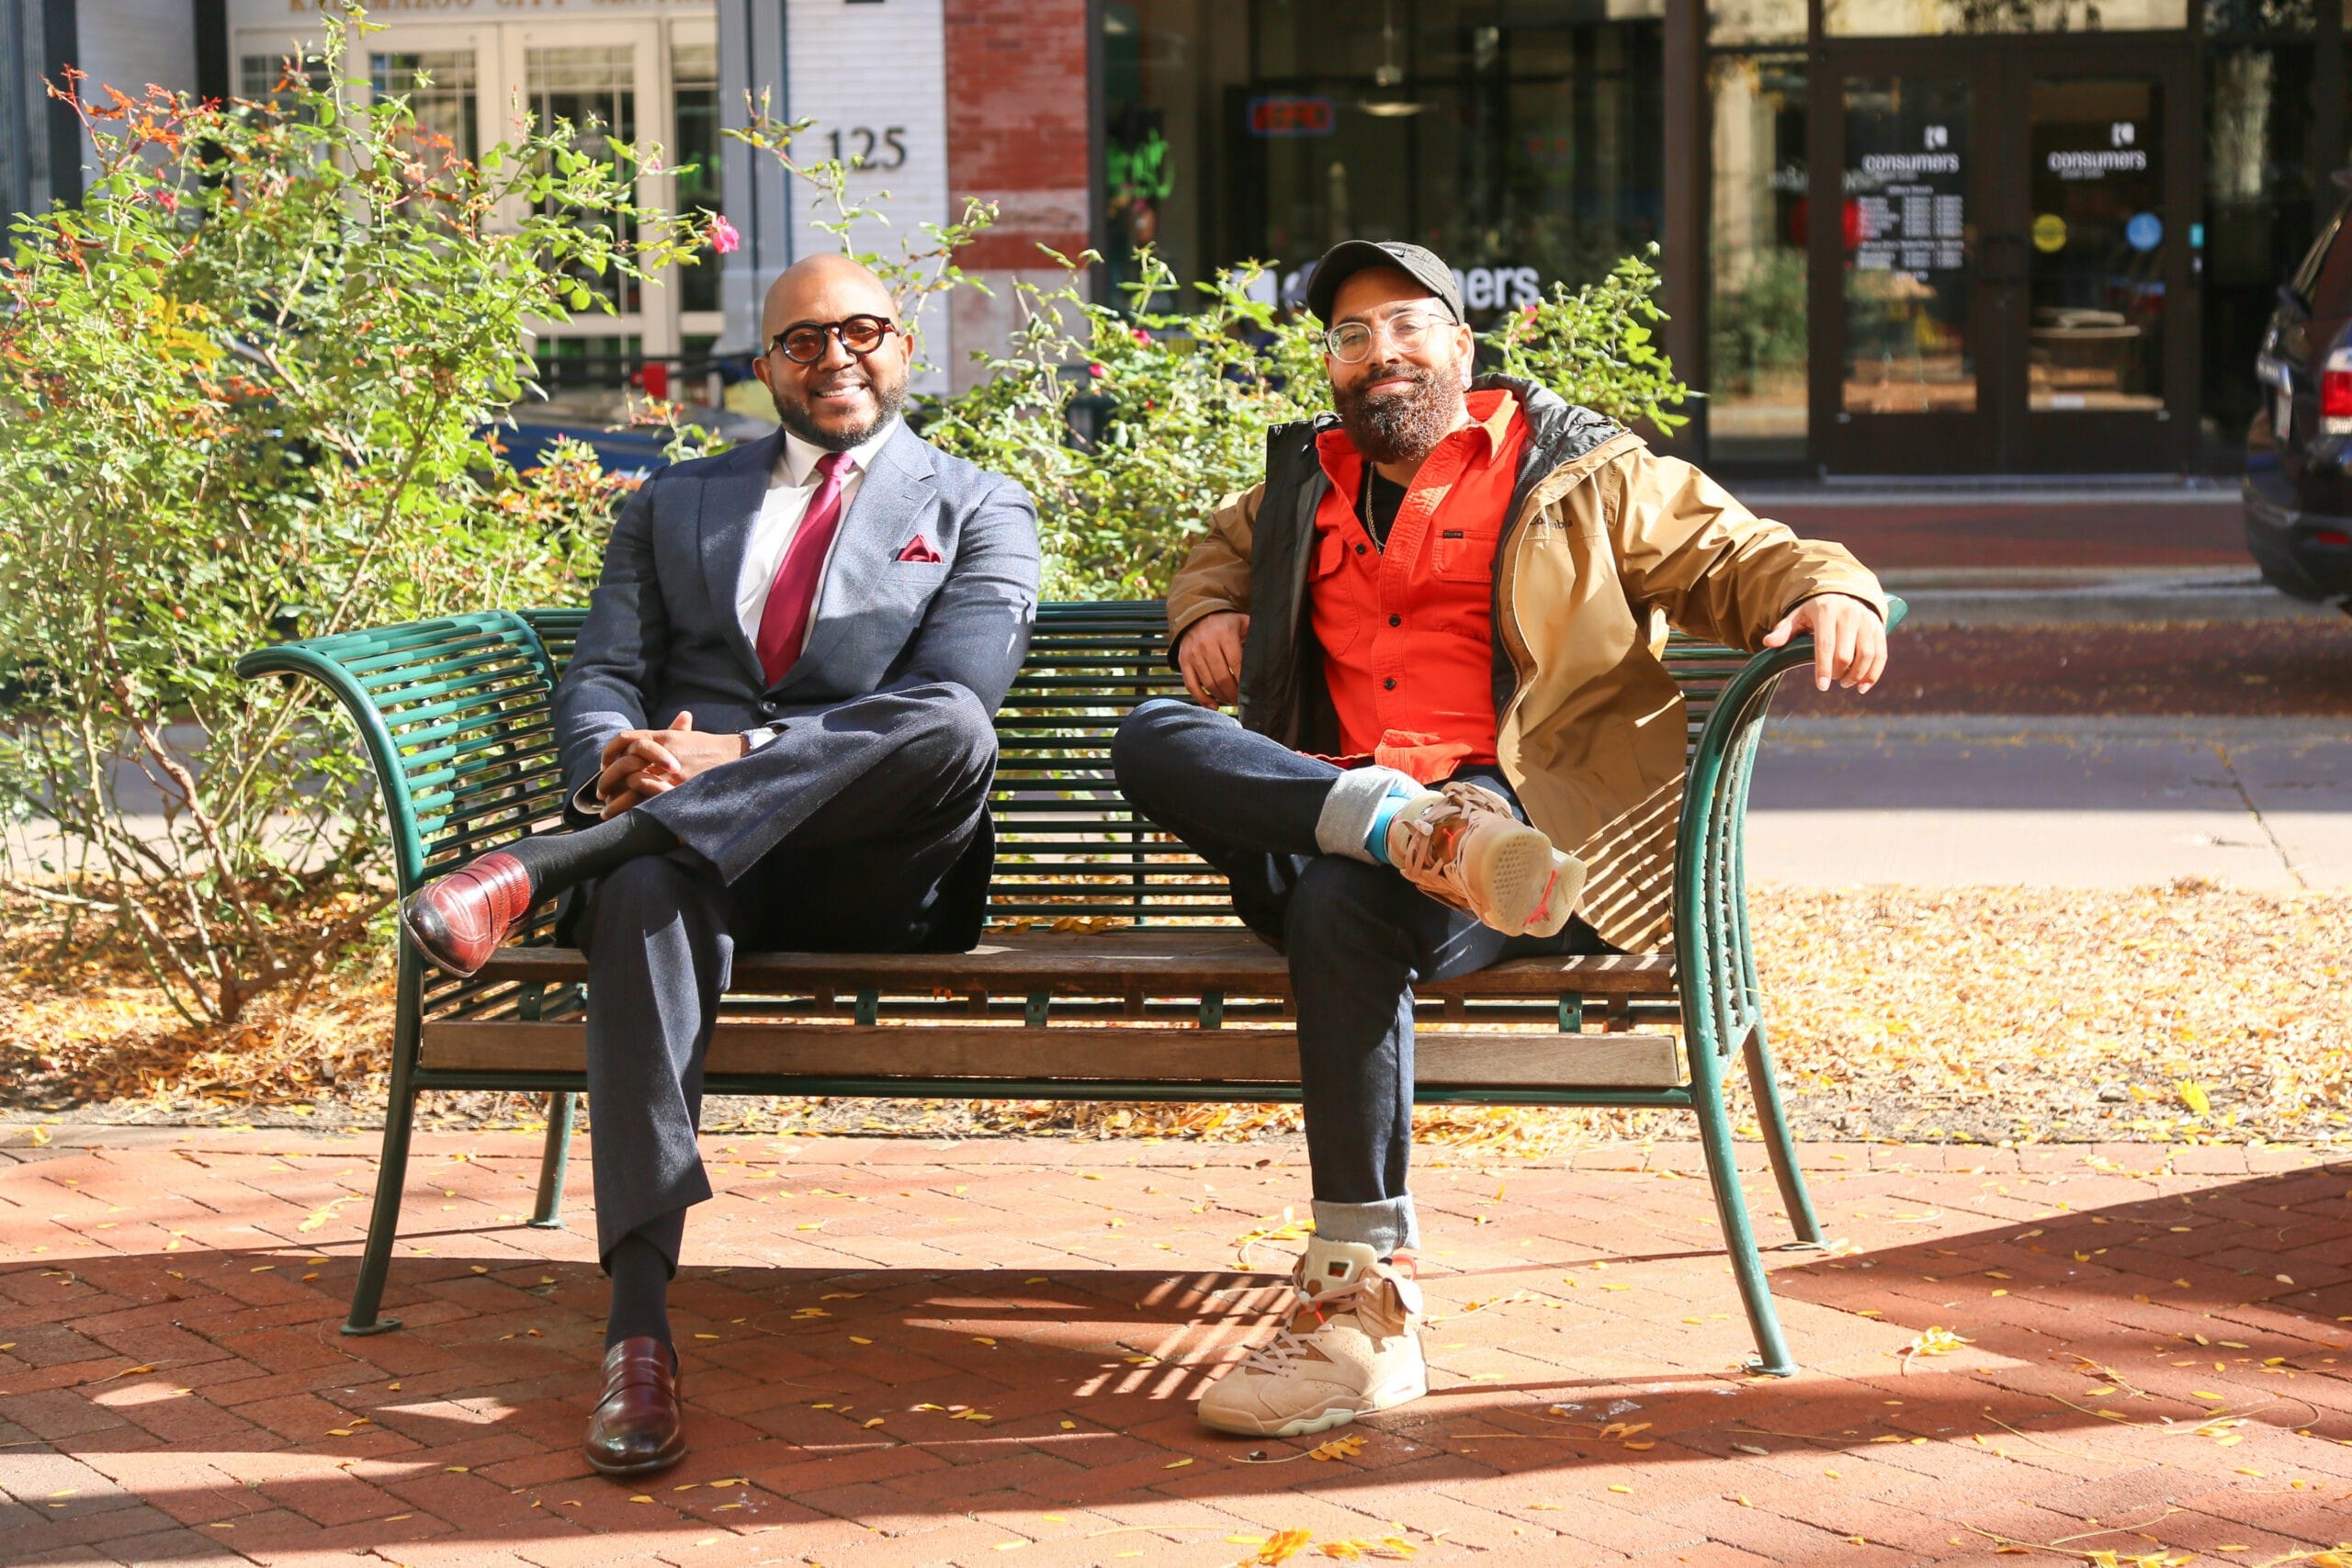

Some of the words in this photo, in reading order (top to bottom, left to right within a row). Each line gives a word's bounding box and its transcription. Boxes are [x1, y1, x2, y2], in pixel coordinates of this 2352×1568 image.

[827, 127, 906, 171] 125
[1861, 153, 1960, 174] consumers
[2047, 151, 2146, 171] consumers
[1530, 515, 1573, 529] Combia
